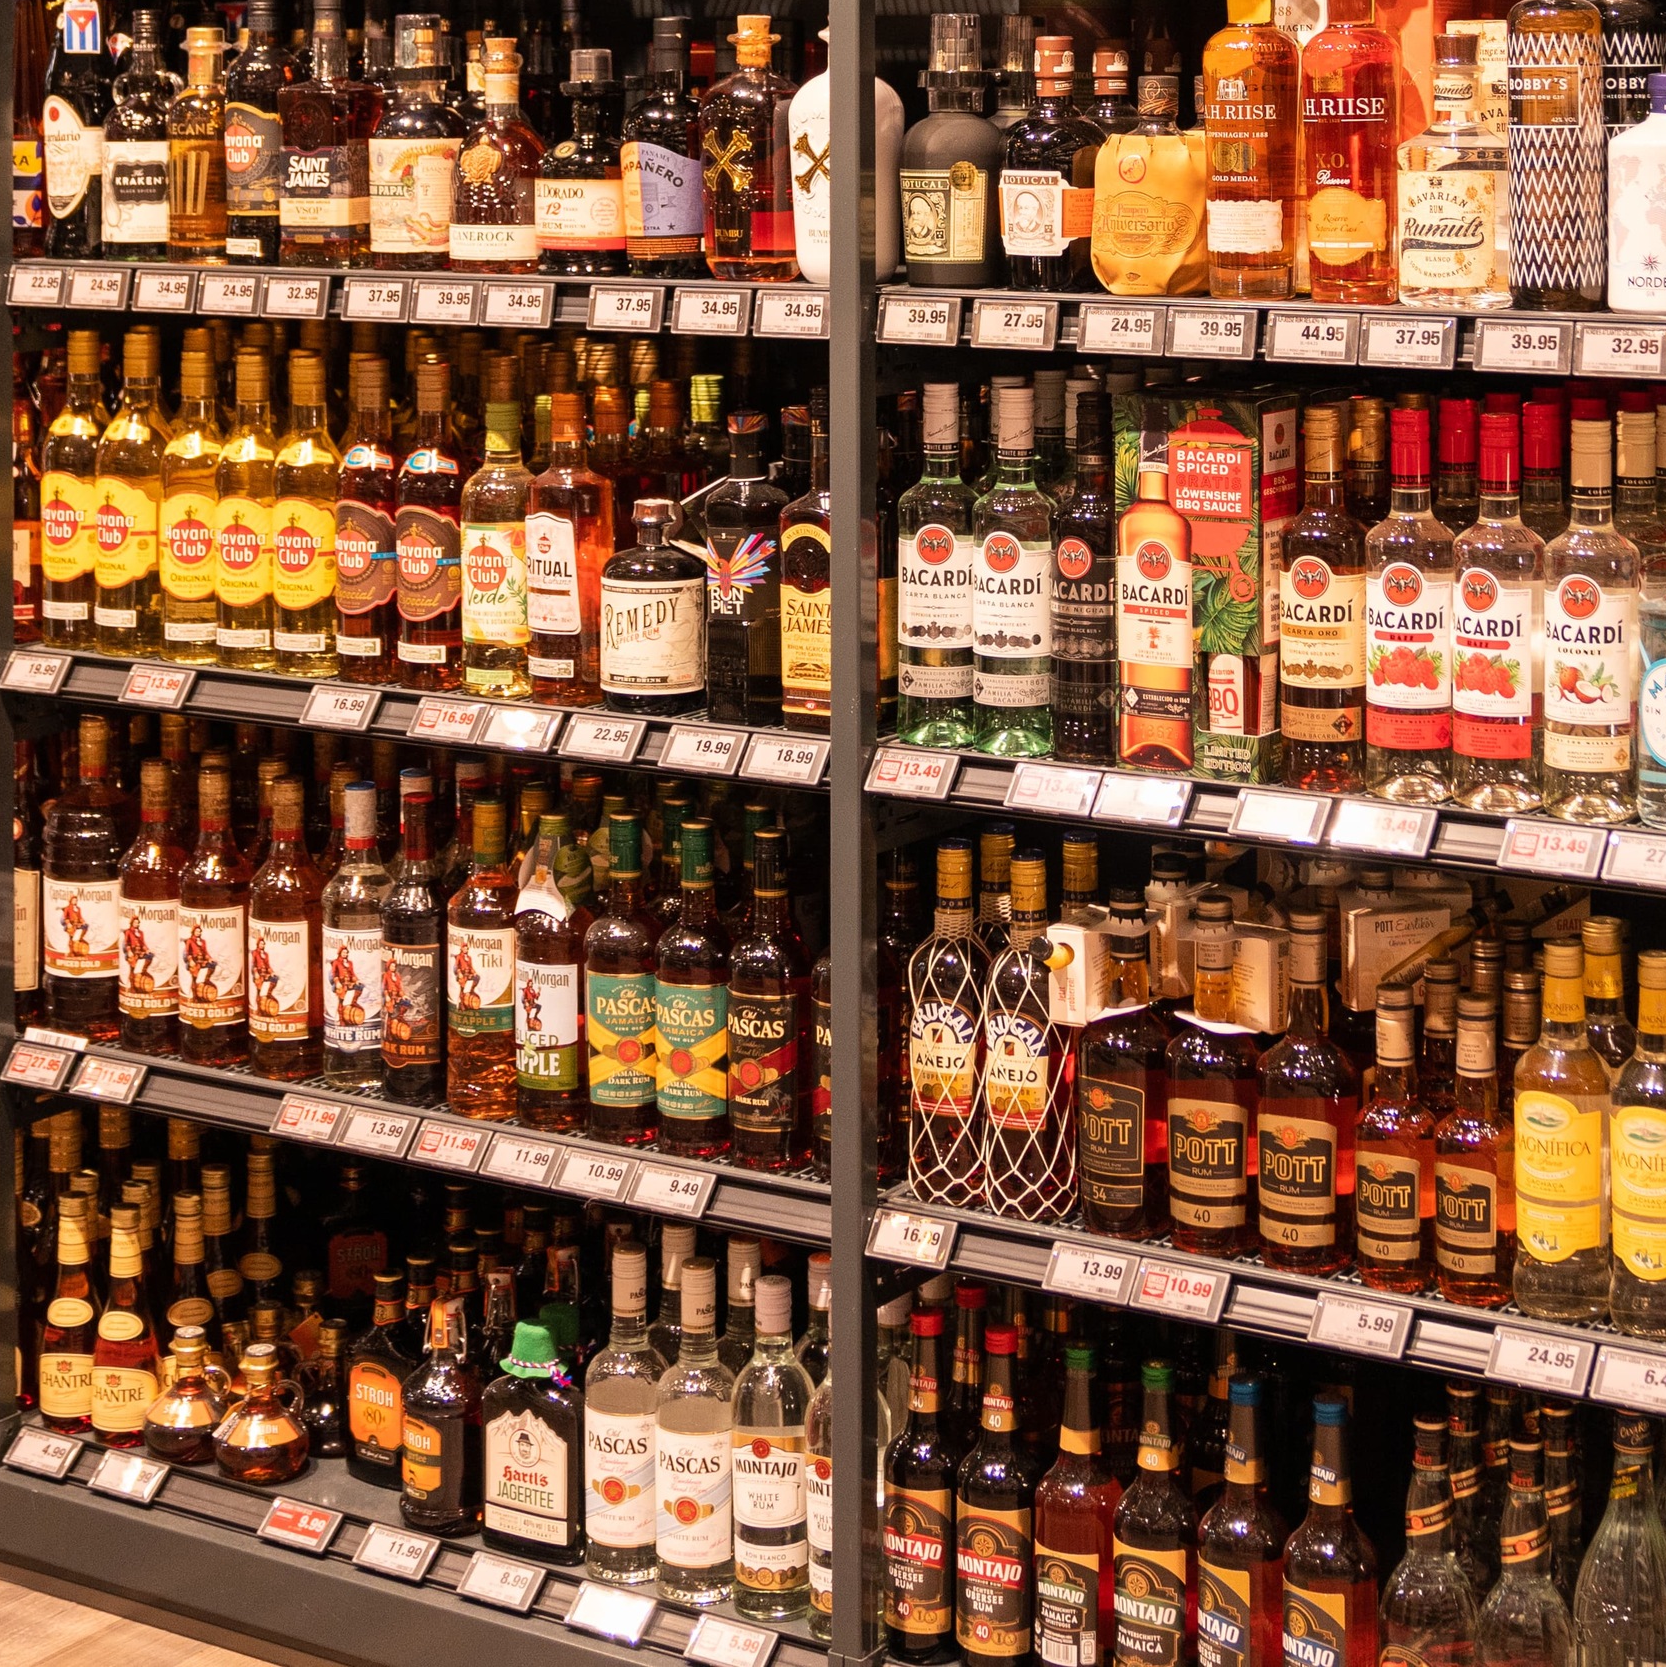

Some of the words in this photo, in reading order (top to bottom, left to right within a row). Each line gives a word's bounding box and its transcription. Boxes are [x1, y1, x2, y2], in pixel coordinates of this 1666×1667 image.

[1508, 75, 1569, 92] BOBBY'S
[289, 153, 330, 175] SAINT
[286, 169, 332, 189] JAMES
[1003, 175, 1059, 185] BOTUCAL
[439, 292, 470, 306] 39.95
[1003, 313, 1043, 329] 27.95
[1111, 317, 1152, 334] 24.95
[1301, 325, 1345, 343] 44.95
[1611, 337, 1660, 357] 32.95
[1177, 449, 1242, 465] BACARDÍ
[1177, 462, 1229, 476] SPICED
[1176, 487, 1242, 501] LÖWENSENF
[1176, 499, 1198, 511] BBQ
[1202, 500, 1242, 513] SAUCE
[173, 541, 208, 557] Club
[527, 557, 572, 579] RITUAL
[786, 599, 830, 622] SAINT
[1280, 600, 1353, 623] BACARDÍ
[1369, 607, 1444, 630] BACARDÍ
[1557, 647, 1603, 656] COCONUT
[150, 677, 180, 691] 13.99
[333, 698, 365, 712] 16.99
[696, 738, 732, 754] 19.99
[1204, 744, 1251, 761] LIMITED
[777, 747, 813, 765] 18.99
[1541, 835, 1588, 855] 13.49
[76, 886, 113, 902] Morgan
[264, 928, 301, 946] Morgan
[597, 995, 657, 1015] PASCAS
[605, 1015, 652, 1025] JAMAICA
[911, 1002, 973, 1044] BRUGAL
[399, 1044, 426, 1056] RUM
[516, 1051, 561, 1076] APPLE
[1174, 1135, 1237, 1165] POTT
[1263, 1152, 1325, 1184] POTT
[669, 1179, 699, 1197] 9.49
[1359, 1180, 1411, 1208] POTT
[1193, 1208, 1211, 1224] 40
[1282, 1226, 1299, 1242] 40
[1170, 1276, 1212, 1298] 10.99
[1358, 1313, 1394, 1332] 5.99
[1527, 1347, 1575, 1369] 24.95
[356, 1382, 393, 1408] STROH
[589, 1434, 649, 1456] PASCAS
[660, 1451, 721, 1474] PASCAS
[735, 1457, 797, 1478] MONTAJO
[497, 1478, 555, 1510] JÄGERTEE
[748, 1490, 780, 1502] WHITE
[389, 1539, 421, 1560] 11.99
[957, 1552, 1023, 1583] MONTAJO
[1118, 1633, 1163, 1655] JAMAICA
